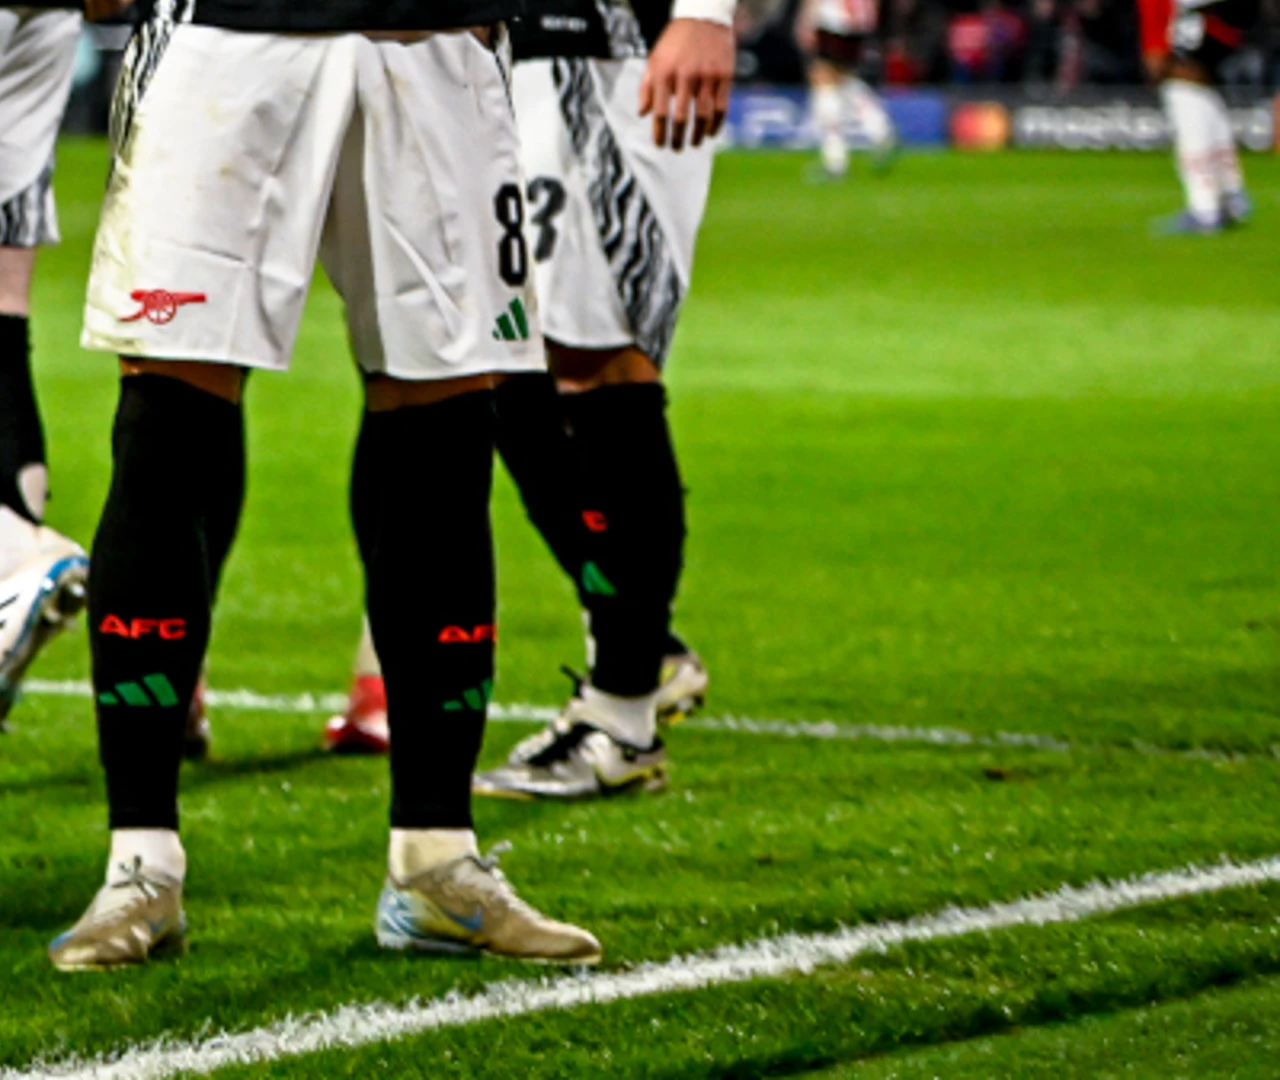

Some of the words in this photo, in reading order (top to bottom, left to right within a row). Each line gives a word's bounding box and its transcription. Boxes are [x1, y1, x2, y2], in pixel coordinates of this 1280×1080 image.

[493, 183, 527, 287] 8
[99, 614, 186, 640] AFC
[439, 624, 496, 642] AF
